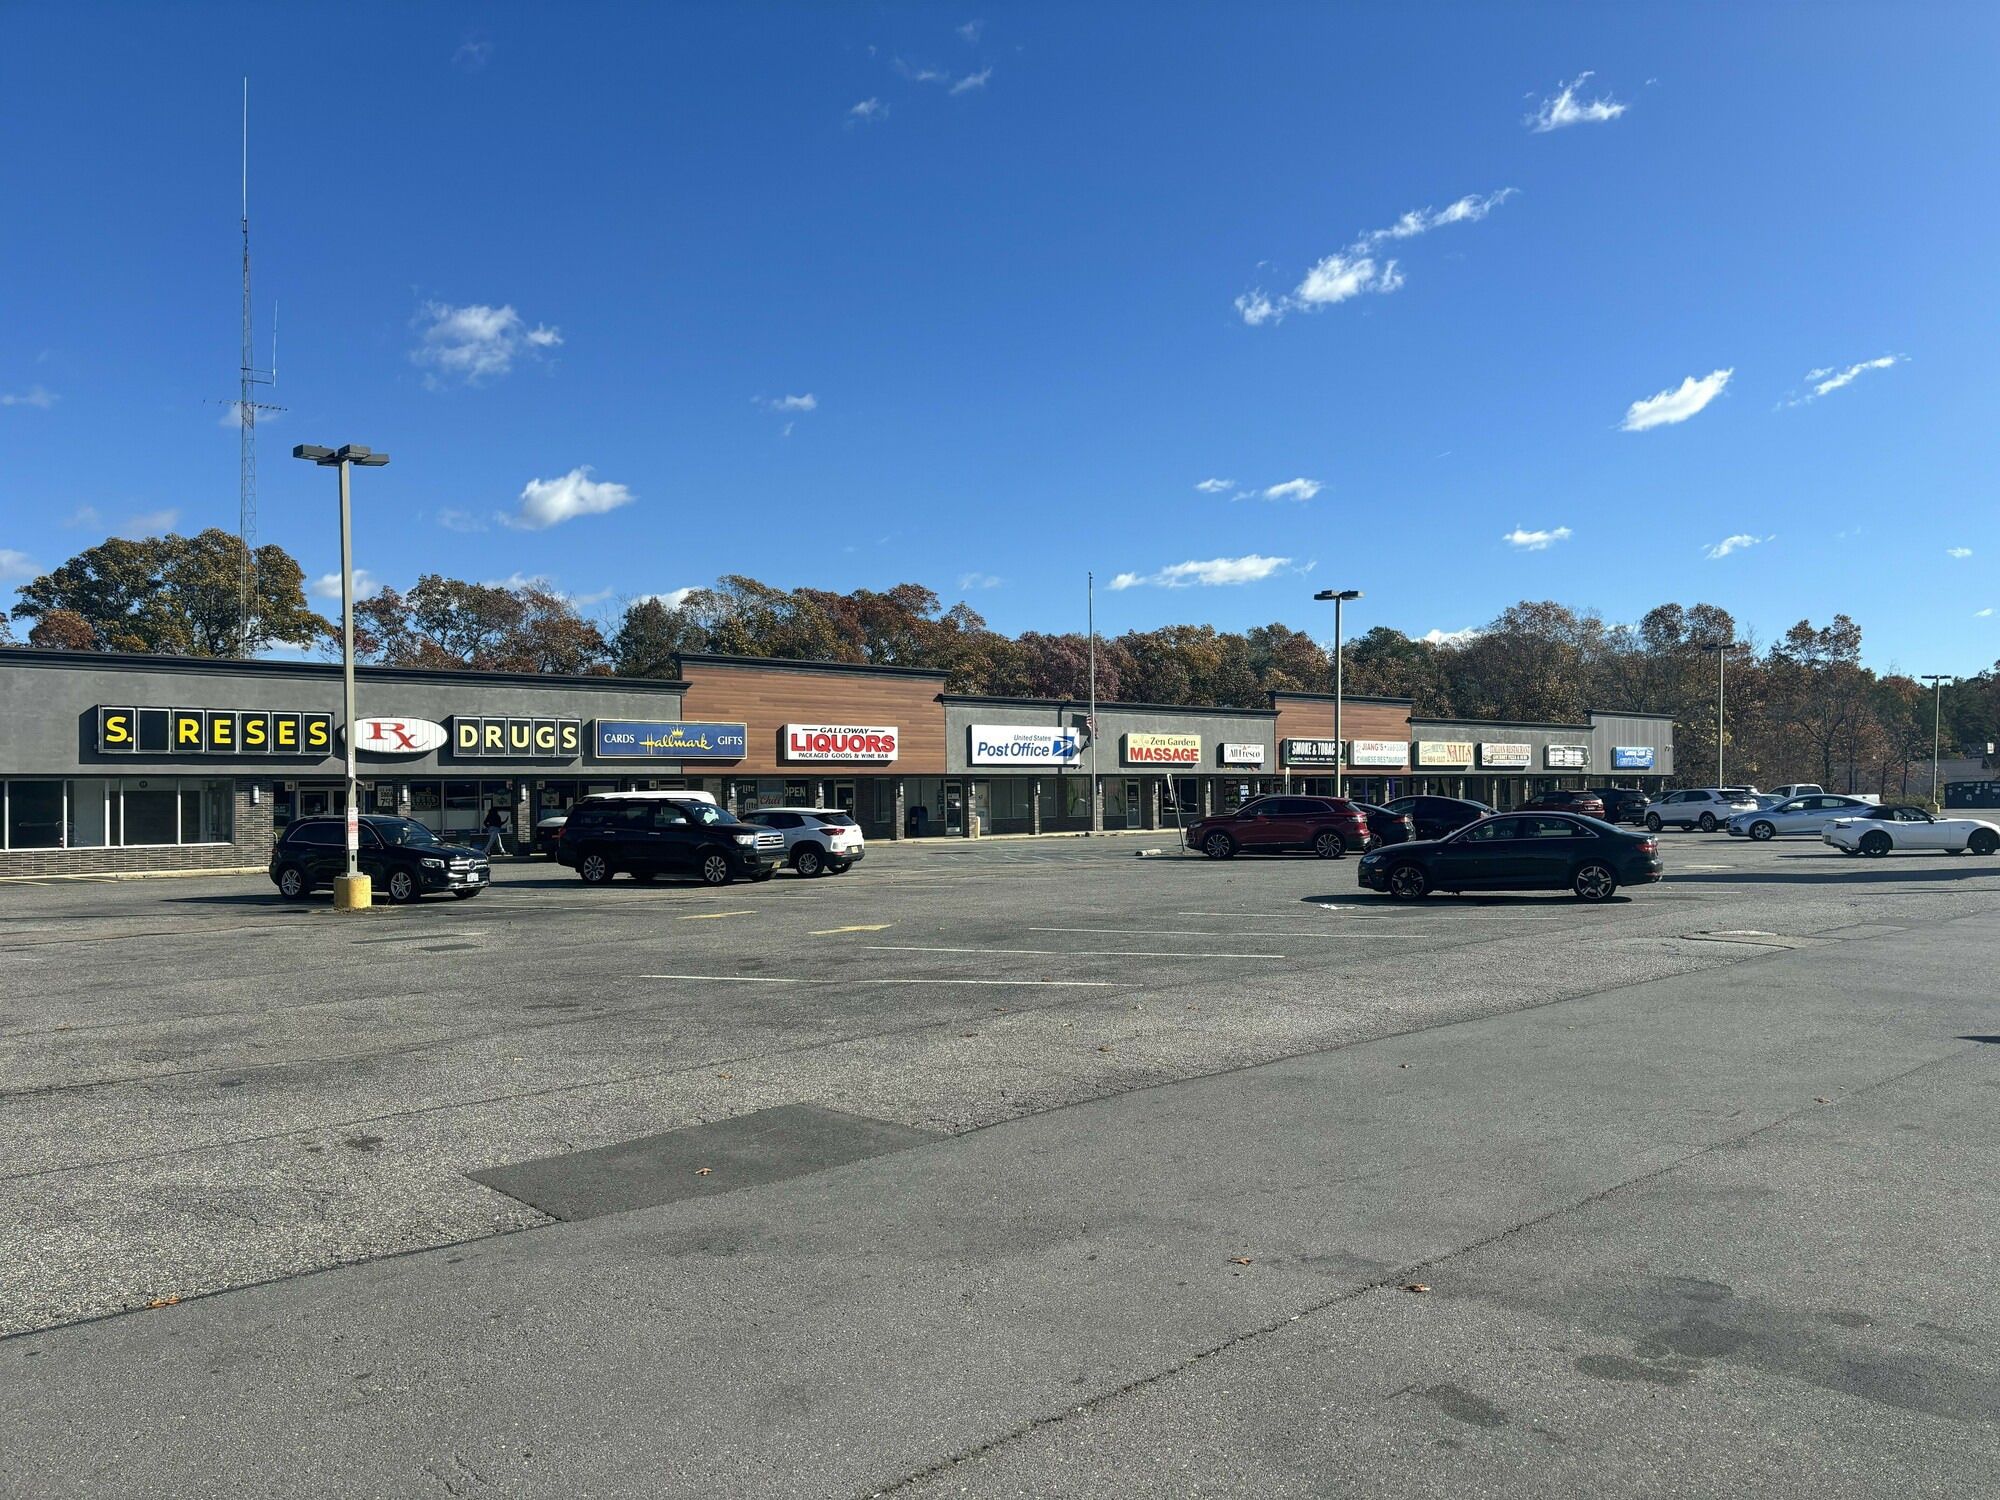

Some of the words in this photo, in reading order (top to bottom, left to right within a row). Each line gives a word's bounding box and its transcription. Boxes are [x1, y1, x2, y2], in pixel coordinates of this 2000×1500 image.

[106, 716, 133, 743] S.
[179, 718, 328, 746] RESES
[459, 725, 577, 749] DRUGS
[1013, 734, 1033, 742] United
[1033, 734, 1052, 742] States
[604, 733, 635, 744] CARDS
[639, 732, 714, 755] Hallmark
[717, 735, 743, 746] GIFTS
[790, 733, 896, 753] LIQUORS
[977, 741, 1010, 757] Post
[1010, 742, 1050, 757] Office
[1150, 737, 1166, 746] Zen
[1167, 737, 1196, 747] Garden
[1292, 741, 1312, 755] SMOKE
[1361, 743, 1384, 751] JIANG'S
[1130, 747, 1199, 762] MASSAGE
[1446, 744, 1472, 763] NAILS
